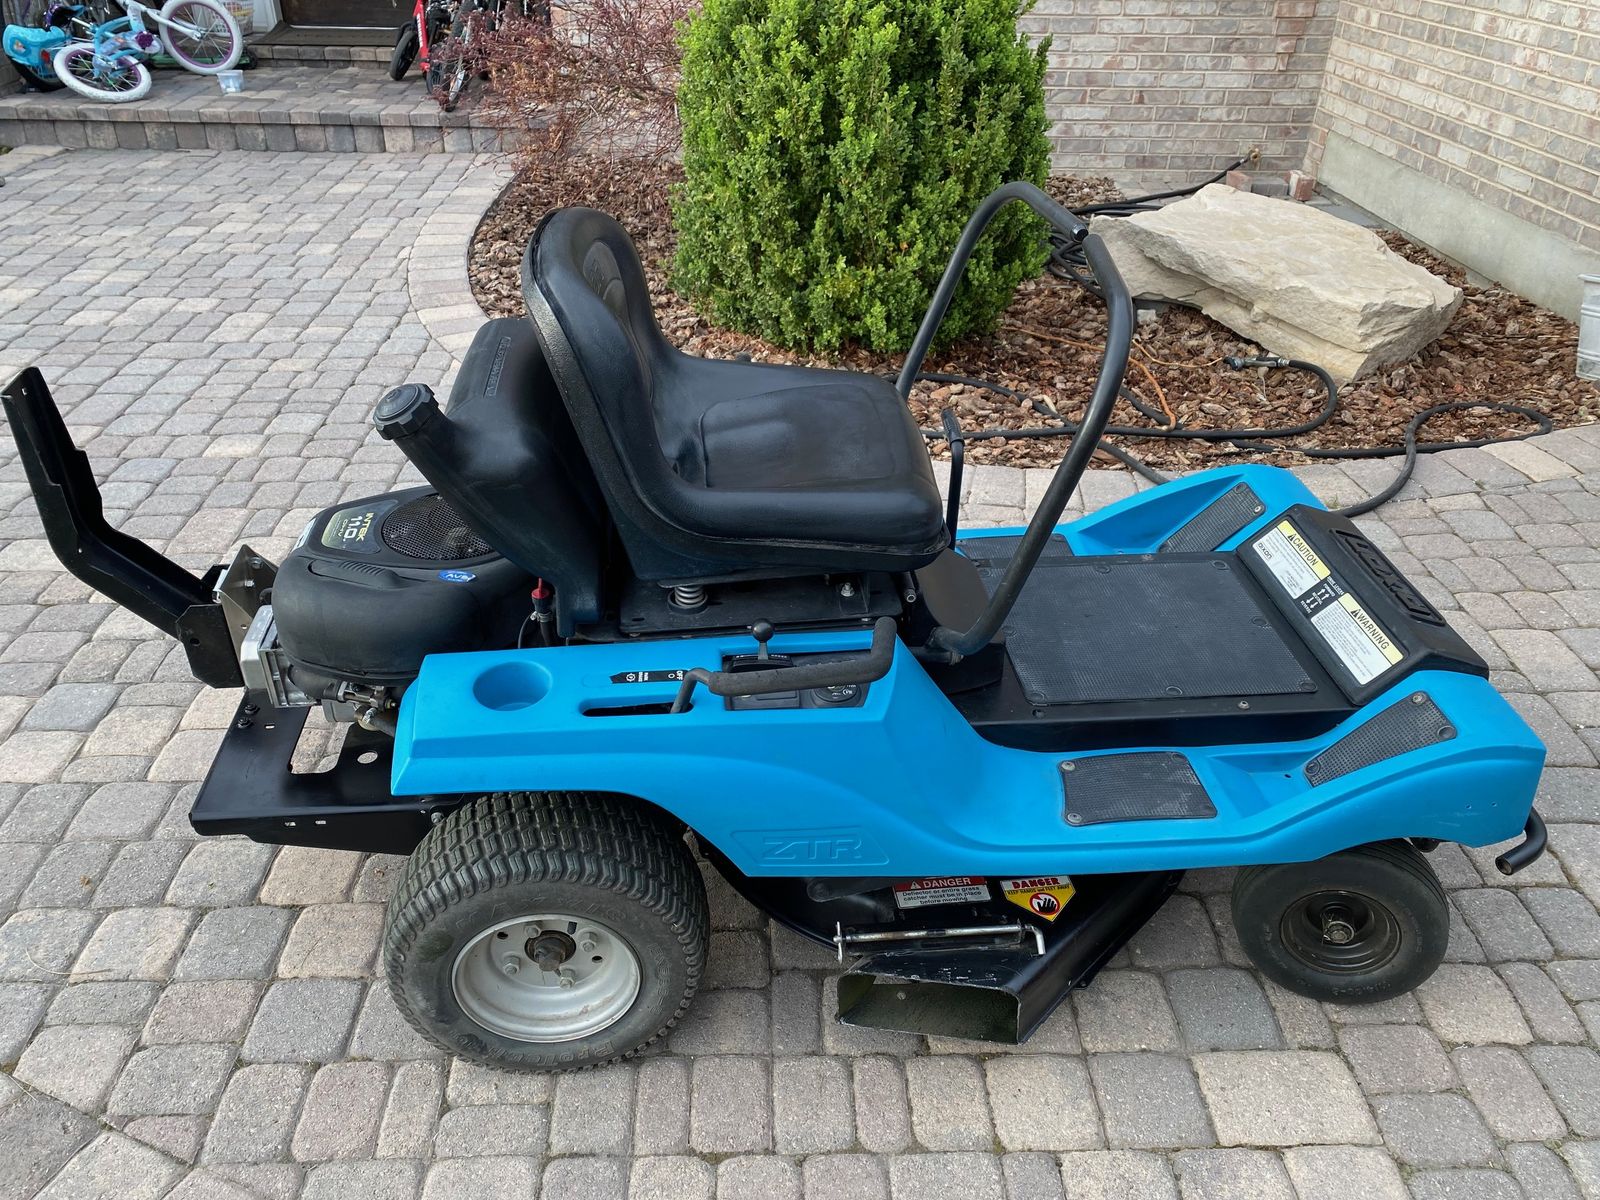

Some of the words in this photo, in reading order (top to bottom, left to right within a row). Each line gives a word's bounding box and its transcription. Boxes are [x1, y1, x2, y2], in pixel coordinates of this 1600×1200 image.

[1291, 537, 1319, 566] CAUTION
[1357, 613, 1390, 650] WARNING
[762, 834, 862, 860] ZTR
[923, 877, 972, 889] DANGER
[1012, 877, 1061, 889] DANGER
